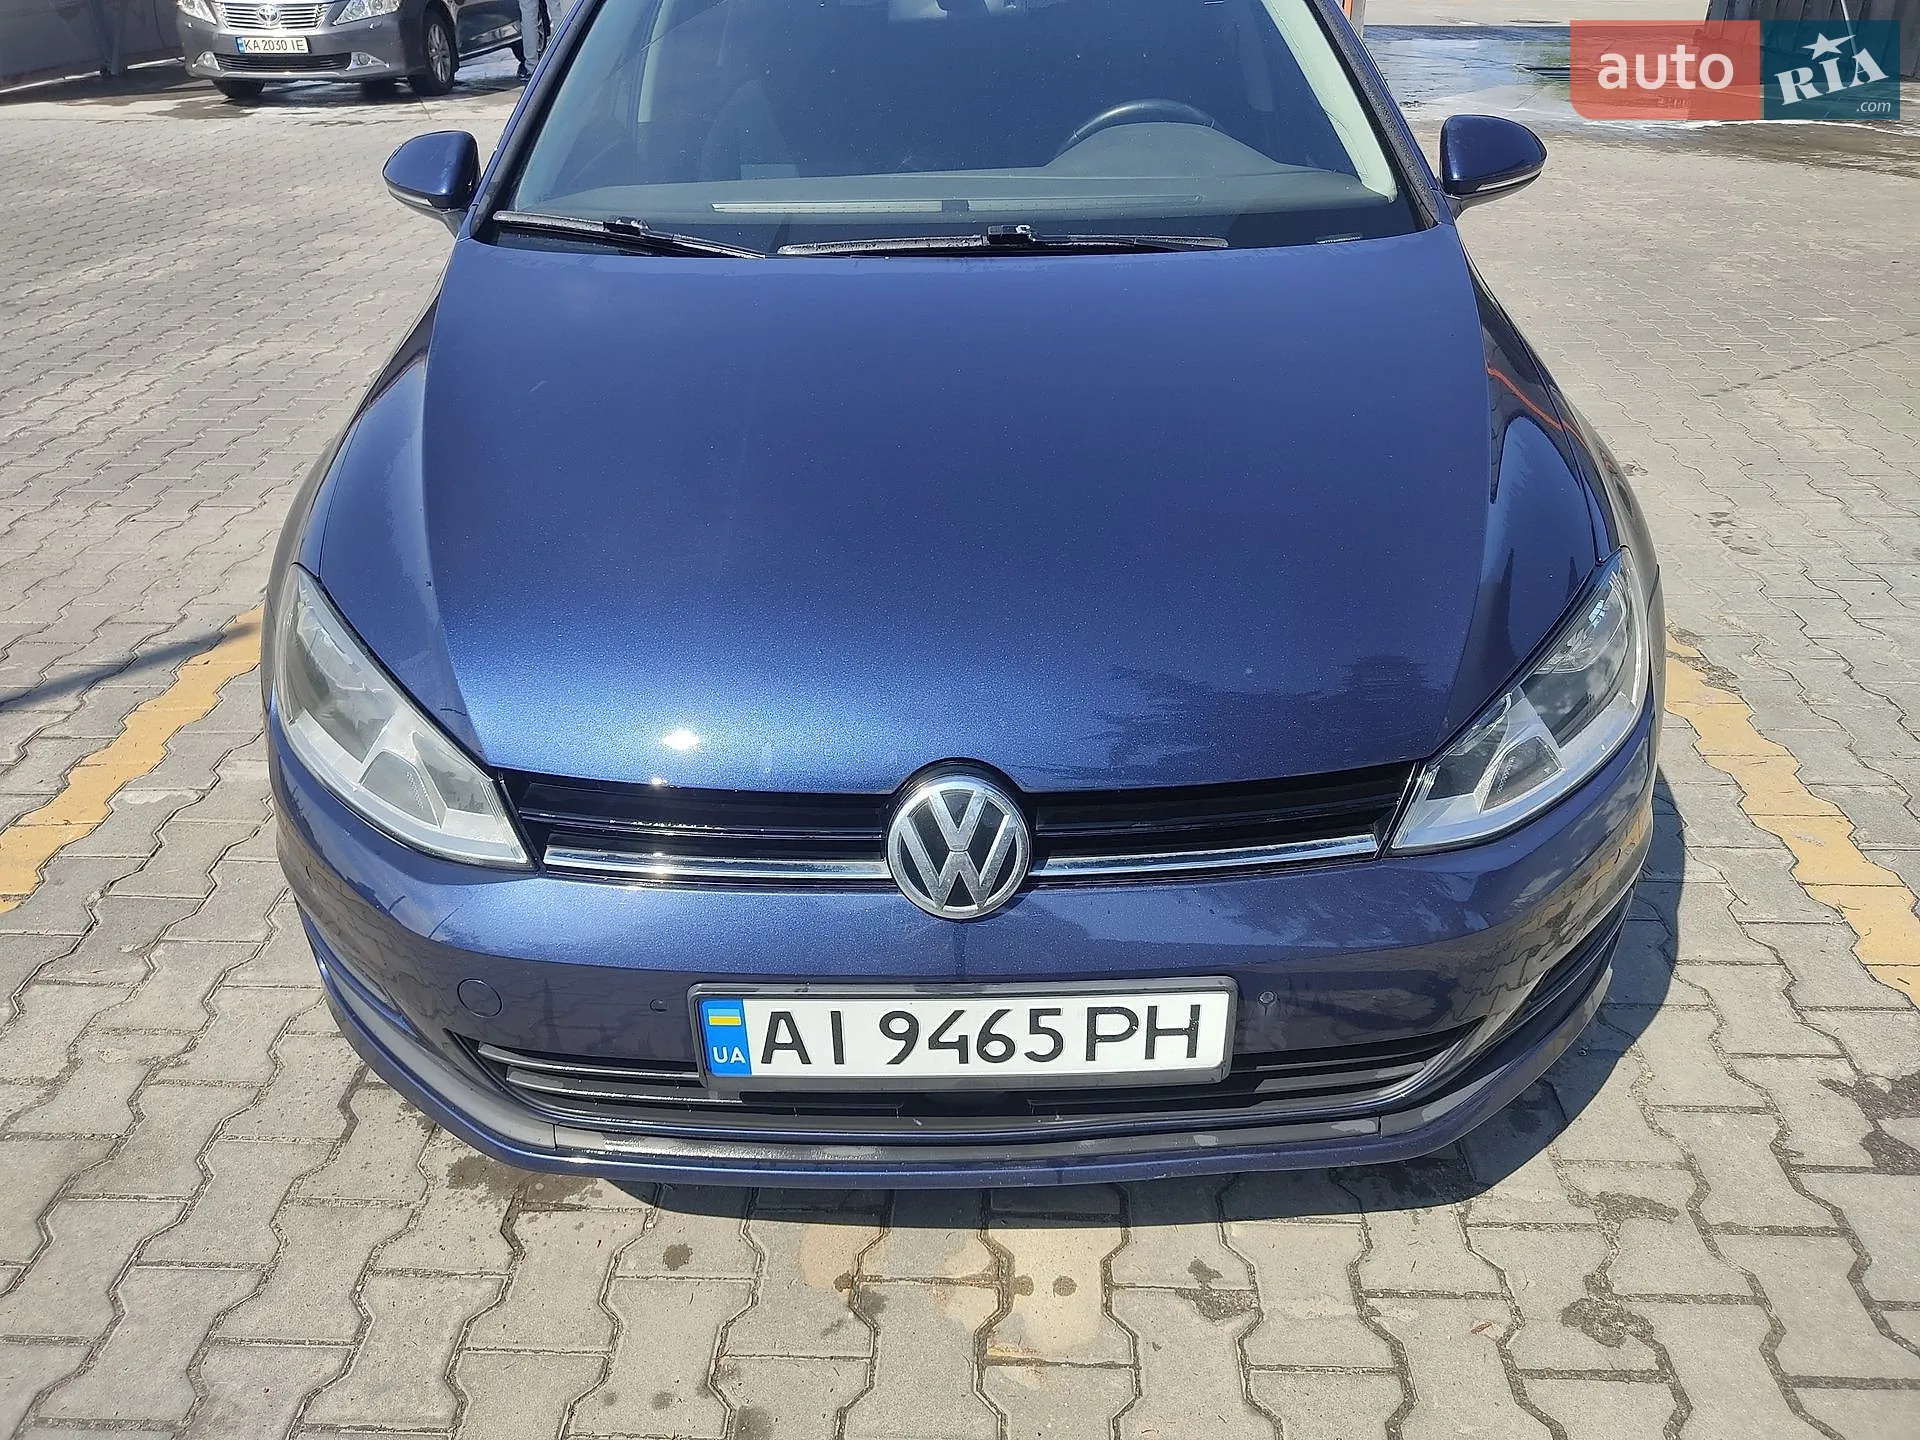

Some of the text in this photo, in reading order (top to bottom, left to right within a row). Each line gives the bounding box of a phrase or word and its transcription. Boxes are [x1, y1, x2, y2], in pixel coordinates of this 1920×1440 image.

[243, 39, 305, 51] KA 2030 IE
[879, 1009, 1064, 1065] 9465
[1085, 1004, 1202, 1062] PH
[714, 1046, 746, 1065] UA
